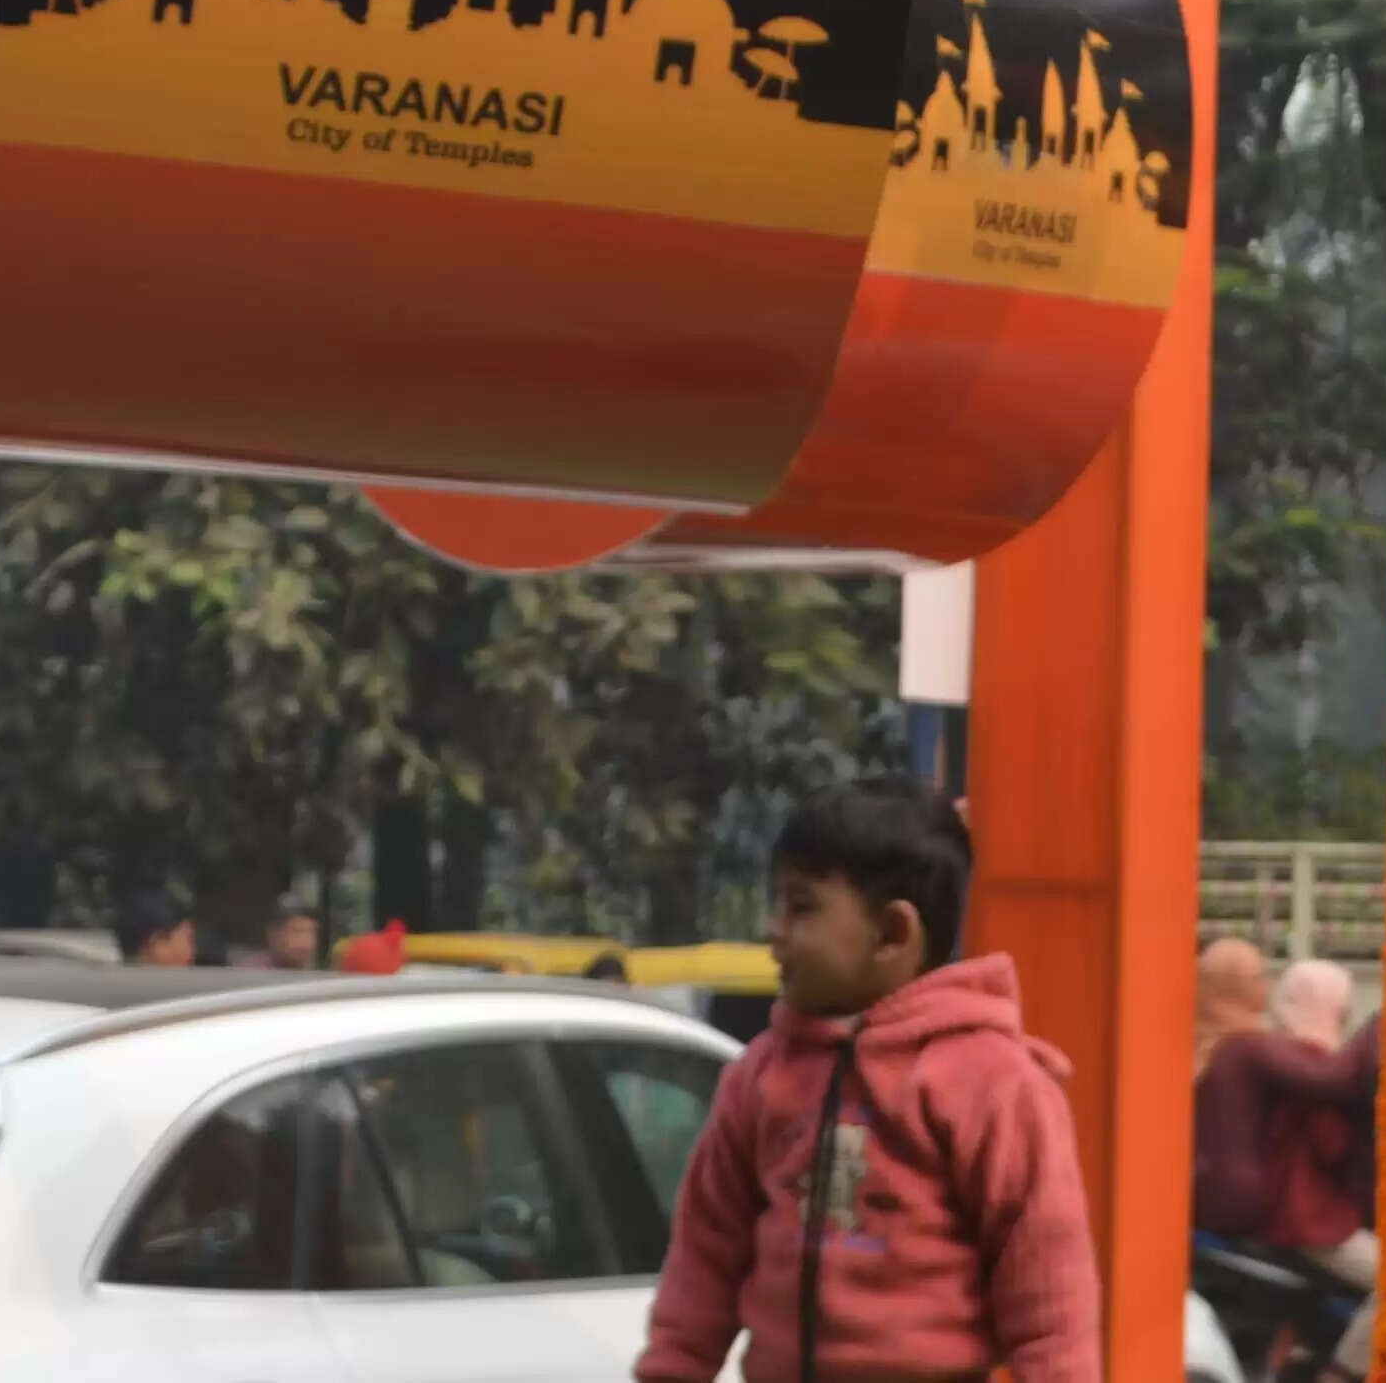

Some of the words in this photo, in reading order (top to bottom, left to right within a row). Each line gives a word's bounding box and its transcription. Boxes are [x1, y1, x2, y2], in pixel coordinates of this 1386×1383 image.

[279, 62, 565, 136] VARANASI
[286, 117, 351, 152] City
[362, 129, 396, 152] of
[404, 131, 534, 168] Temples
